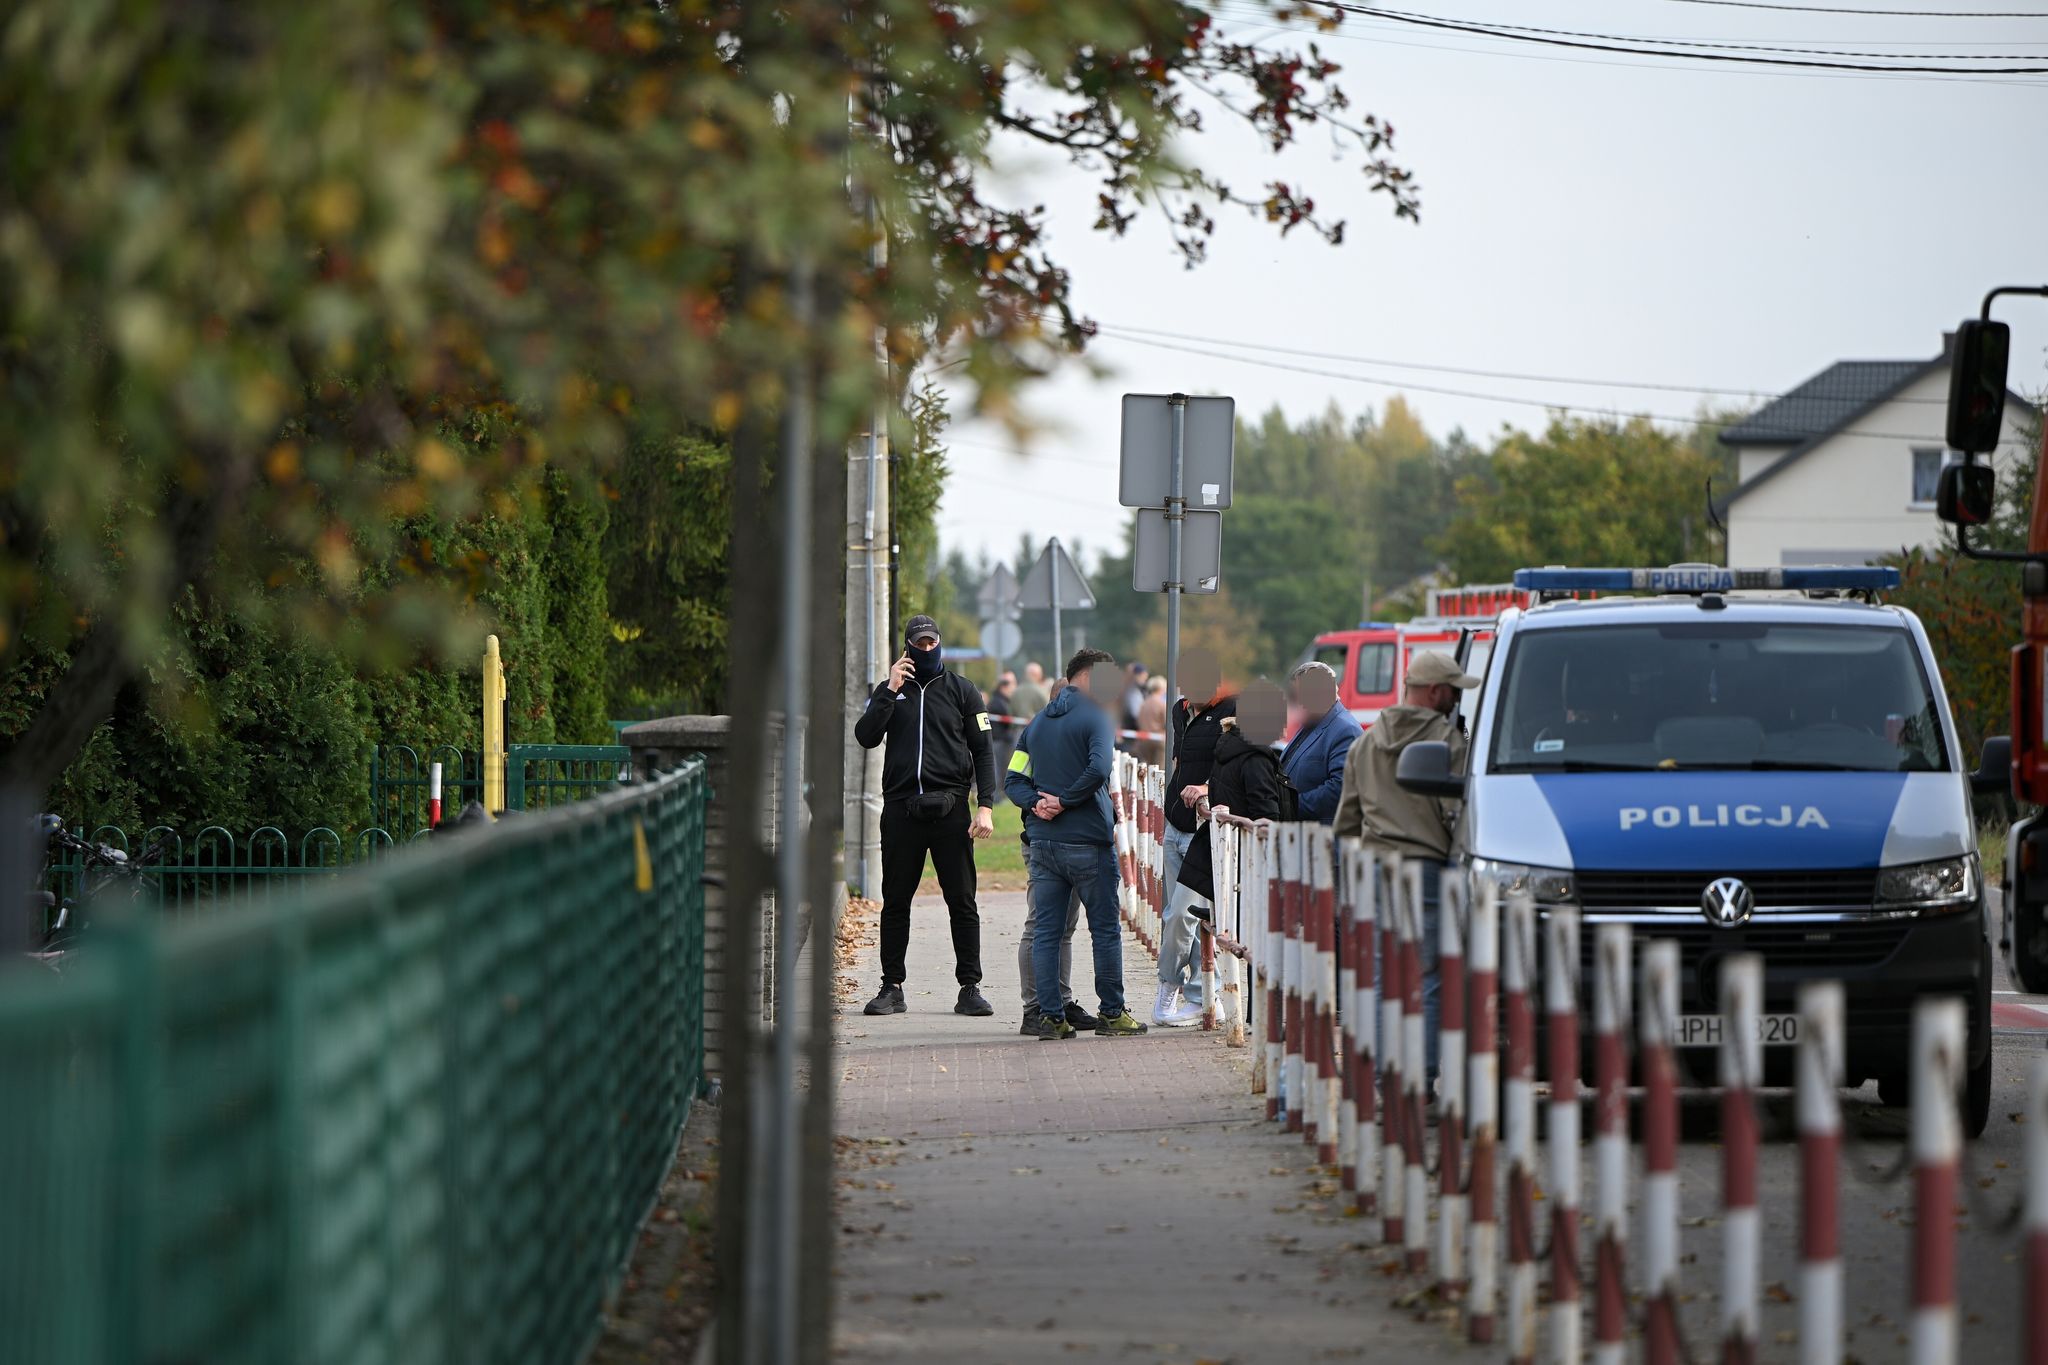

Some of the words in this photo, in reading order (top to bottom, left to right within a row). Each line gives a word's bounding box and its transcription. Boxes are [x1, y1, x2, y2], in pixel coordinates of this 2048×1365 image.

[1651, 571, 1734, 590] POLICJA
[1619, 804, 1830, 831] POLICJA
[1672, 1017, 1723, 1043] HPH
